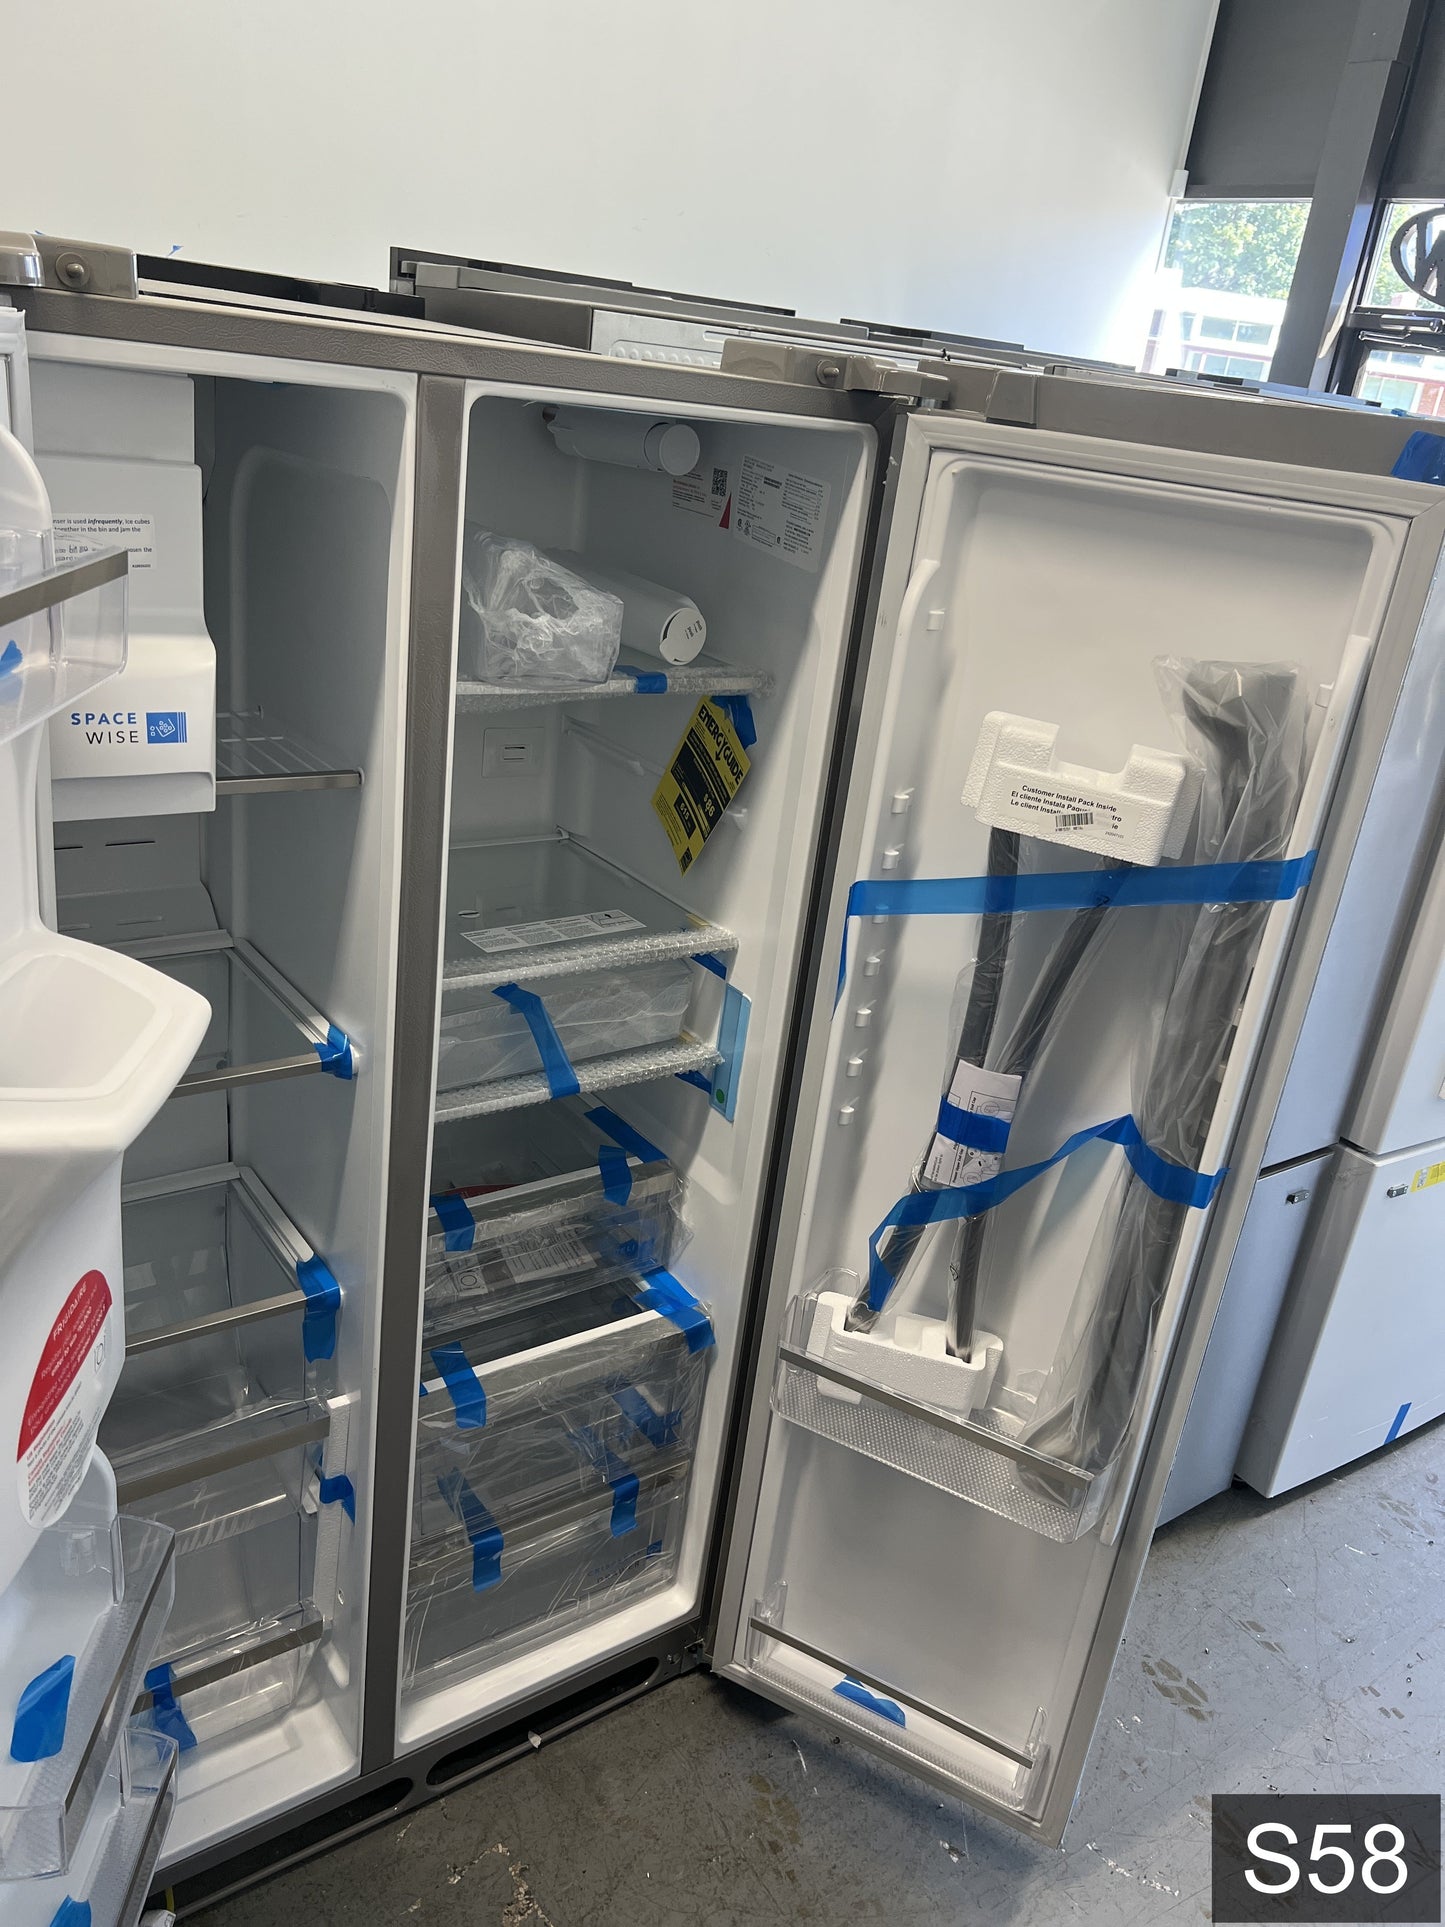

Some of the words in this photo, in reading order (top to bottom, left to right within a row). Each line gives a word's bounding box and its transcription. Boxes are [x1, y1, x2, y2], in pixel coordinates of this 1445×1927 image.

[88, 518, 124, 526] infrequently,
[71, 712, 137, 725] SPACE
[86, 730, 139, 745] WISE
[1010, 798, 1019, 806] Le
[1020, 802, 1040, 811] client
[1020, 793, 1042, 803] cliente
[1042, 798, 1066, 808] Instala
[1022, 784, 1054, 798] Customer
[1056, 792, 1077, 803] Install
[1078, 797, 1094, 808] Pack
[1096, 802, 1117, 812] Inside
[53, 1281, 87, 1342] FRIGIDAIRE
